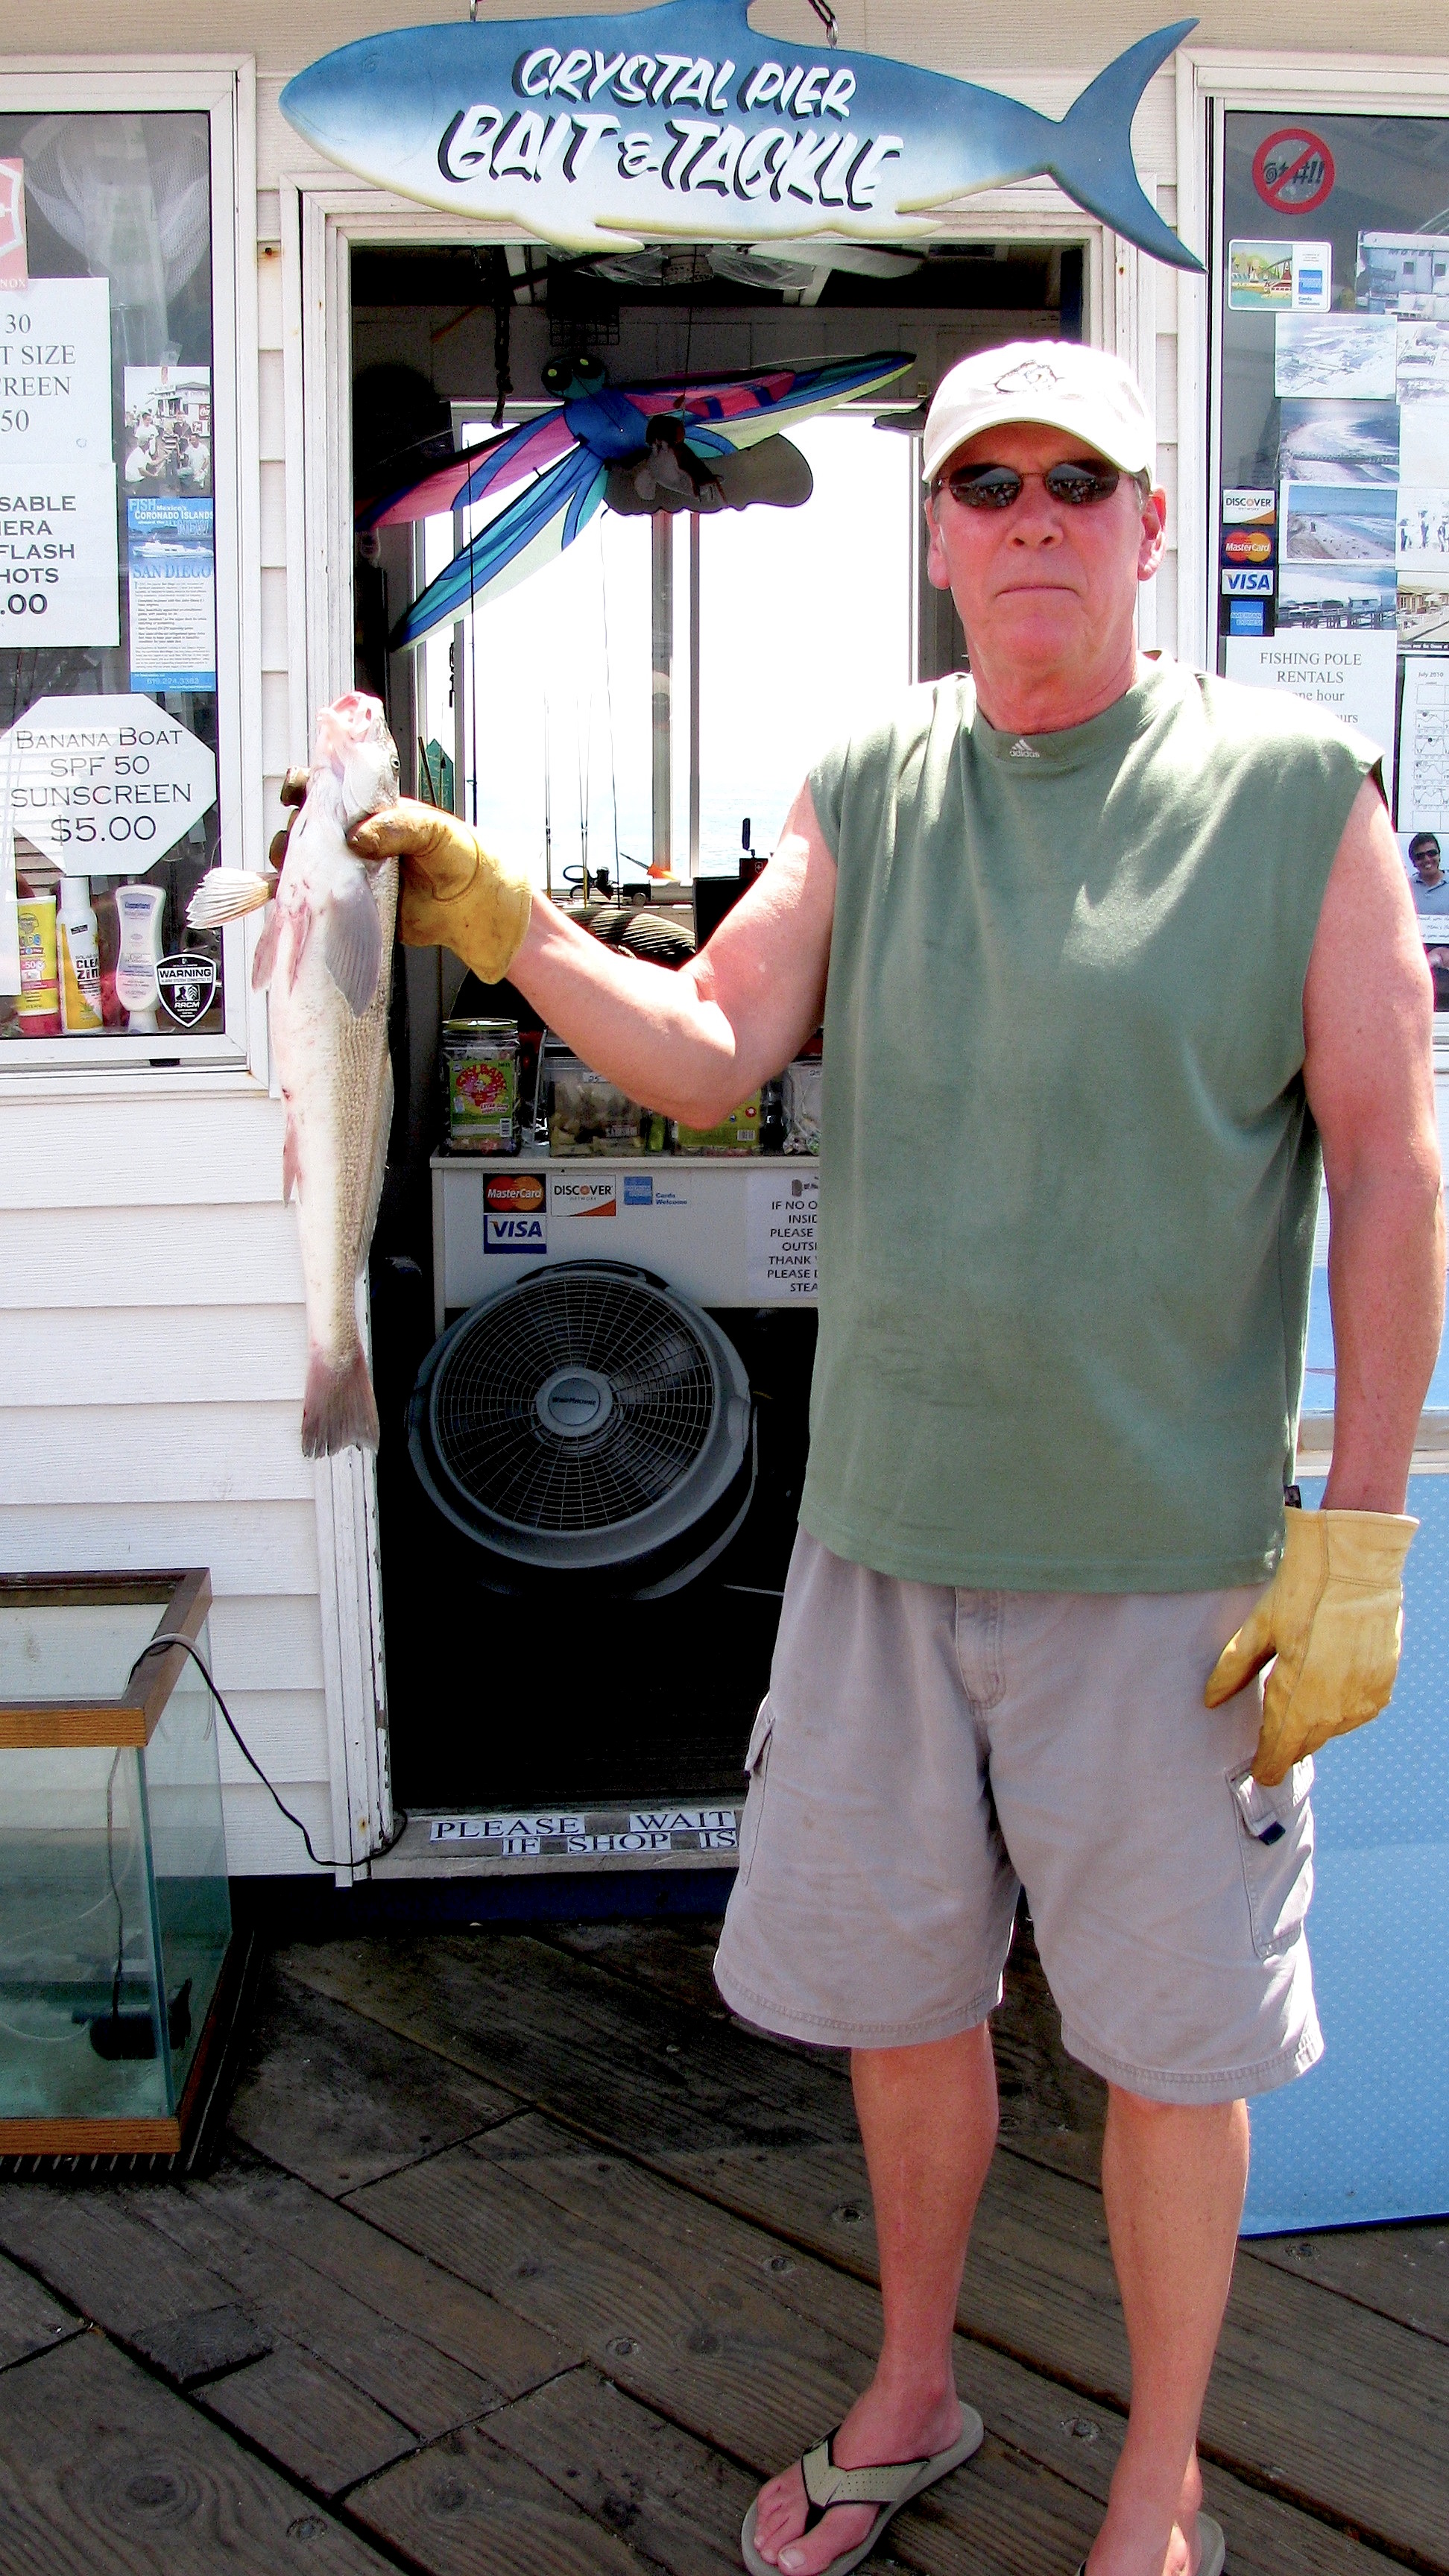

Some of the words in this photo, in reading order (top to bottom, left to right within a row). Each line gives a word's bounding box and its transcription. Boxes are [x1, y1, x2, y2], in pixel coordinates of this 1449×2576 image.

[516, 48, 735, 115] CRYSTAL
[740, 63, 857, 120] PIER
[438, 104, 621, 183] BAIT
[619, 133, 659, 178] &
[663, 118, 904, 211] TACKLE
[6, 314, 31, 334] 30
[22, 345, 76, 365] SIZE
[0, 376, 71, 396] REEN
[1, 409, 29, 432] 50
[0, 496, 76, 511] SABLE
[130, 499, 156, 511] FISH
[1225, 498, 1272, 507] DISCOVER
[135, 511, 179, 520] CORONADO
[181, 511, 213, 520] ISLANDS
[0, 520, 53, 535] ERA
[1225, 543, 1271, 552] MasterCard
[133, 564, 161, 578] SAN
[165, 564, 212, 578] DIEGO
[1225, 574, 1270, 590] VISA
[1260, 652, 1319, 665] FISHING
[1325, 653, 1362, 666] POLE
[1277, 671, 1344, 684] RENTALS
[1316, 689, 1345, 701] hour
[16, 731, 111, 749] BANANA
[119, 727, 183, 745] BOAT
[50, 757, 105, 777] SPF
[115, 756, 150, 775] 50
[11, 783, 191, 807] SUNSCREEN
[51, 815, 156, 846] $5.00
[160, 969, 211, 978] WARNING
[487, 1188, 543, 1199] MasterCard
[554, 1185, 613, 1196] DISCOVER
[771, 1202, 782, 1210] IF
[786, 1201, 804, 1210] NO
[490, 1221, 543, 1237] VISA
[771, 1228, 813, 1237] PLEASE
[783, 1242, 817, 1251] OUTSI
[769, 1256, 811, 1265] THANK
[768, 1269, 810, 1278] PLEASE
[436, 1817, 579, 1838] PLEASE
[636, 1811, 732, 1830] WAIT
[508, 1838, 539, 1853] IF
[569, 1832, 669, 1852] SHOP
[701, 1831, 736, 1848] IS
